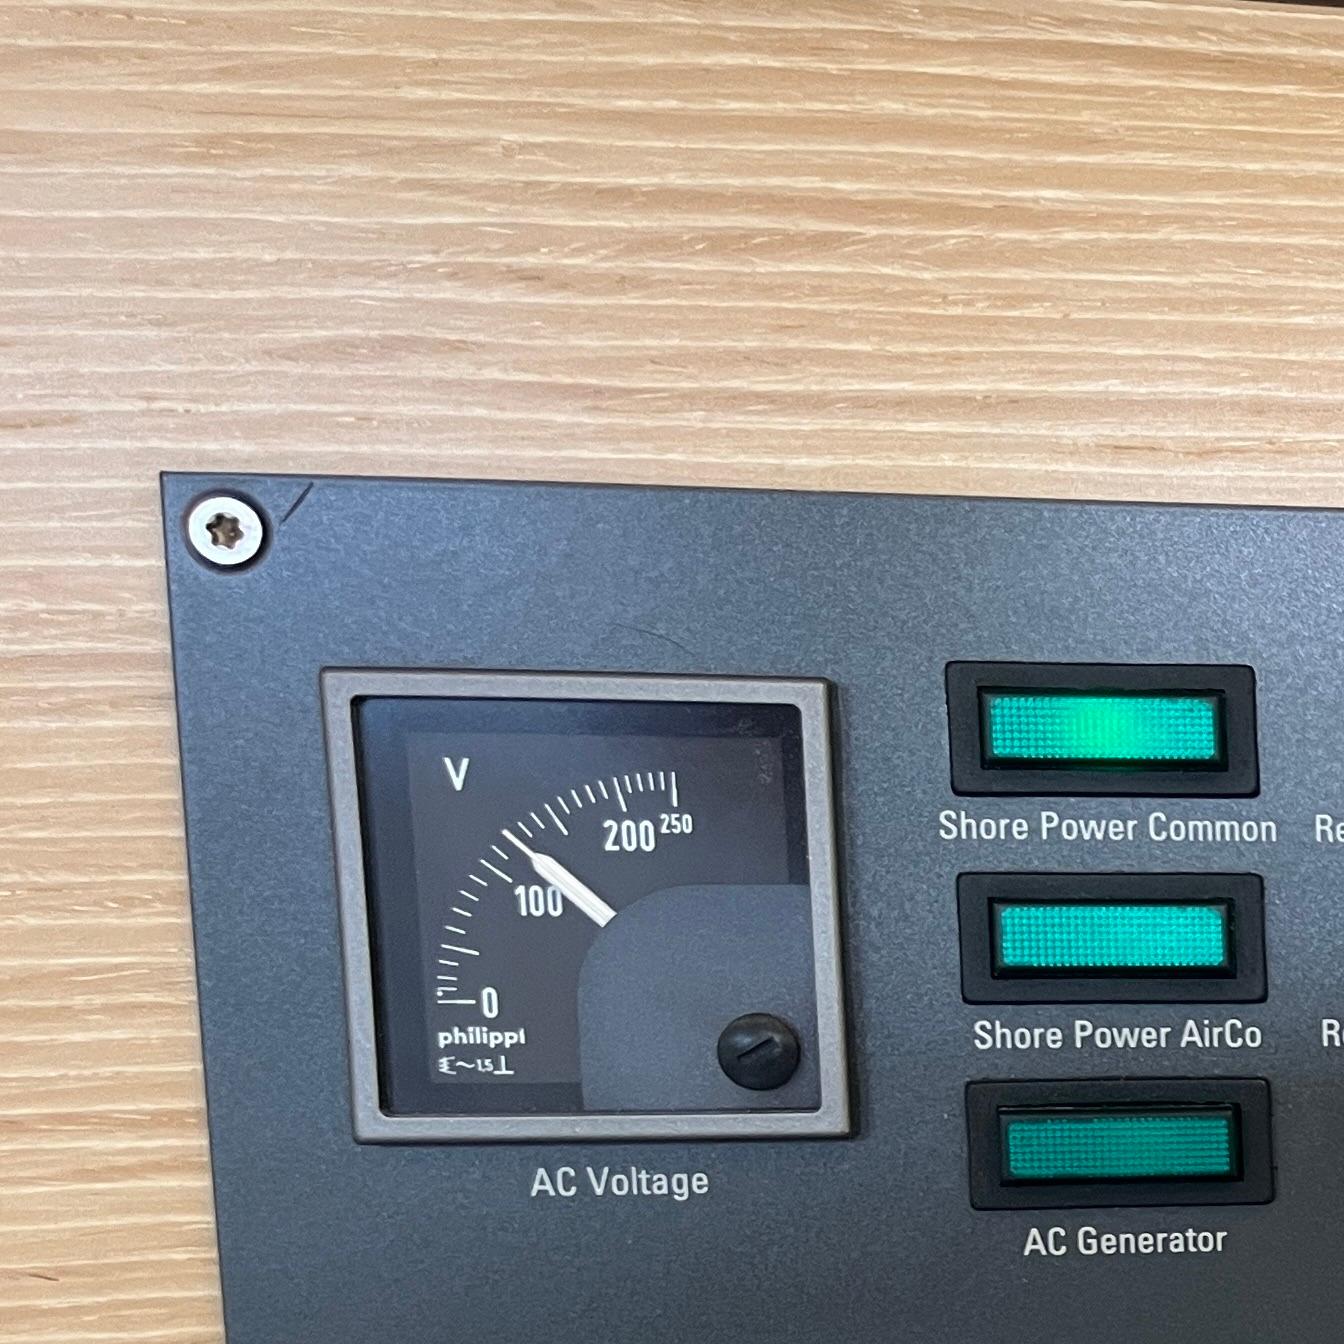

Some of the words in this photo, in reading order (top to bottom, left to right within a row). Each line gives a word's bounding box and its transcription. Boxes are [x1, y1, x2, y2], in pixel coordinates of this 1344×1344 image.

[443, 756, 470, 791] V
[602, 819, 656, 852] 200
[659, 813, 693, 834] 250
[939, 809, 1029, 840] Shore
[1040, 811, 1138, 841] Power
[1148, 811, 1277, 842] Common
[513, 884, 563, 918] 100
[481, 986, 499, 1019] 0
[437, 1026, 526, 1049] philippi
[973, 1020, 1063, 1050] Shore
[1074, 1019, 1172, 1049] Power
[1180, 1018, 1262, 1048] AirCo
[530, 1166, 577, 1197] AC
[586, 1166, 709, 1202] Voltage
[1023, 1226, 1067, 1256] AC
[1077, 1226, 1228, 1255] Generator
